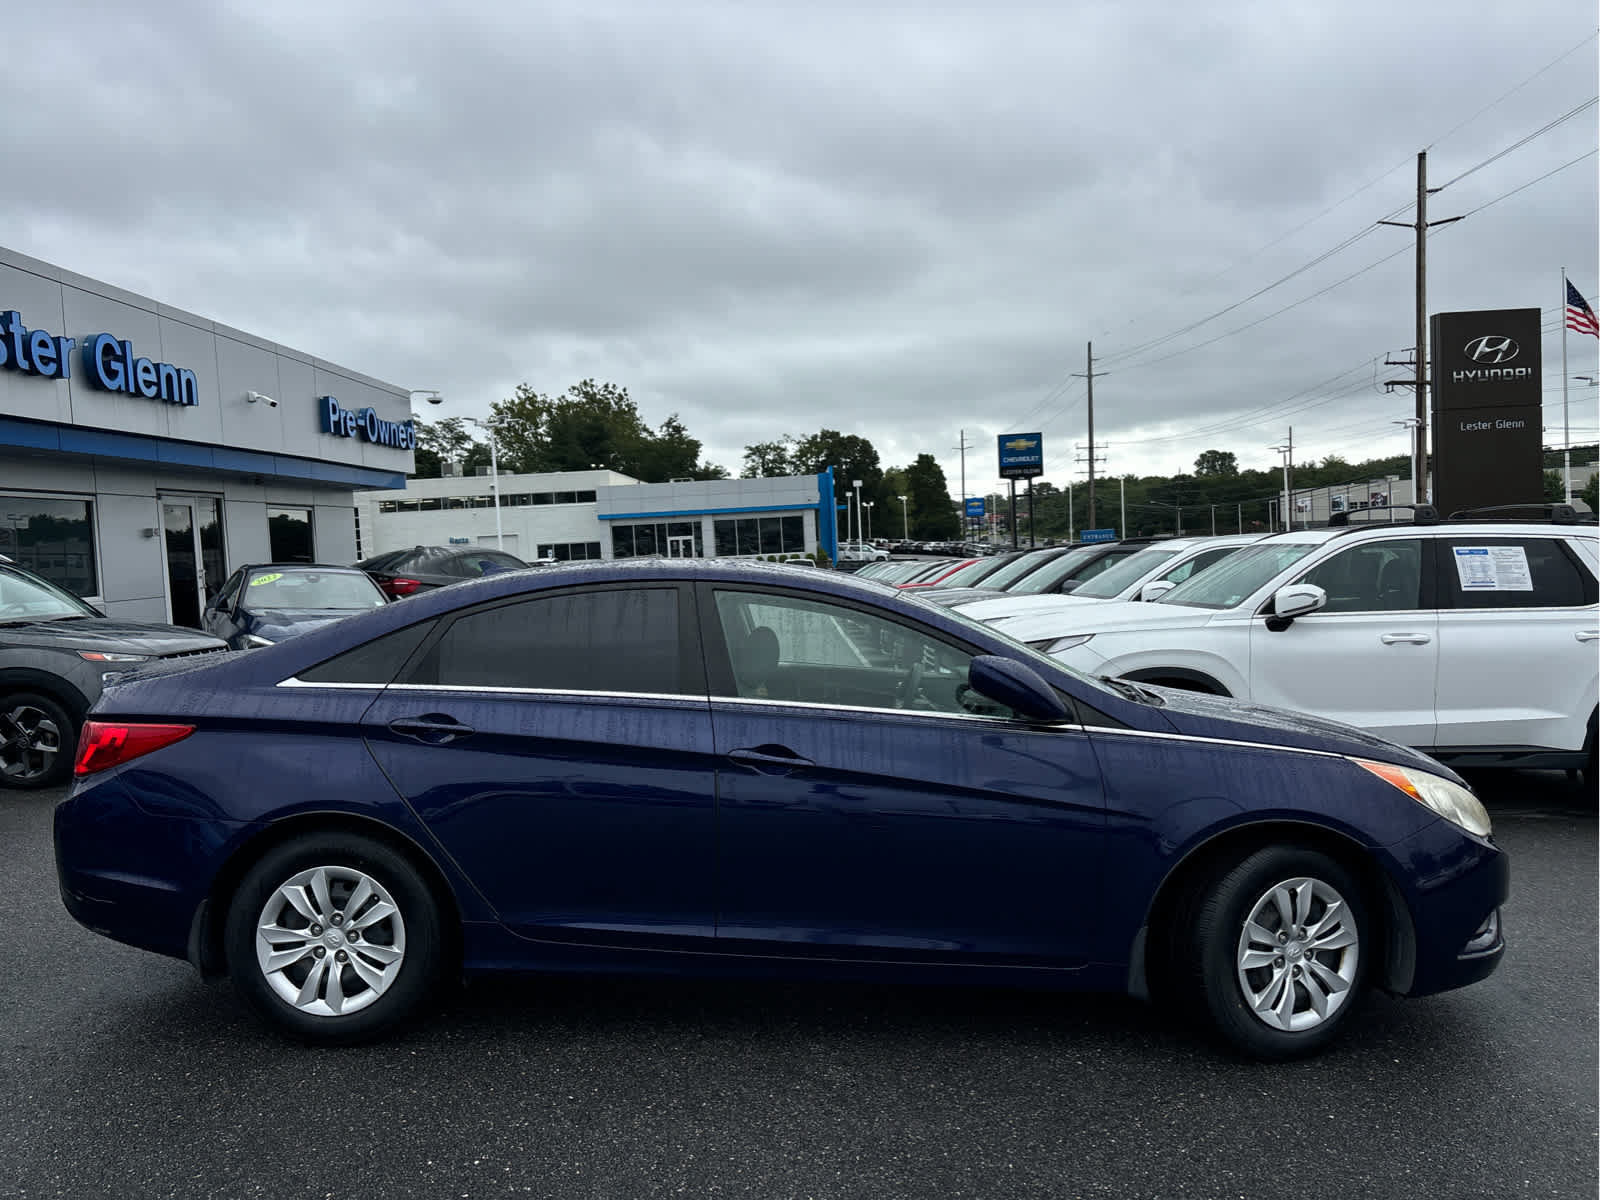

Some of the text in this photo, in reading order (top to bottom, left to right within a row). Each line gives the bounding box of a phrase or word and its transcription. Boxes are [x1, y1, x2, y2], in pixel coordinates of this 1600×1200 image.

[86, 333, 199, 406] Glenn
[1453, 367, 1532, 382] HYUNDAI
[323, 396, 416, 450] Pre-Owned
[1460, 419, 1525, 432] Lester Glenn
[1003, 455, 1040, 464] CHEVROLET
